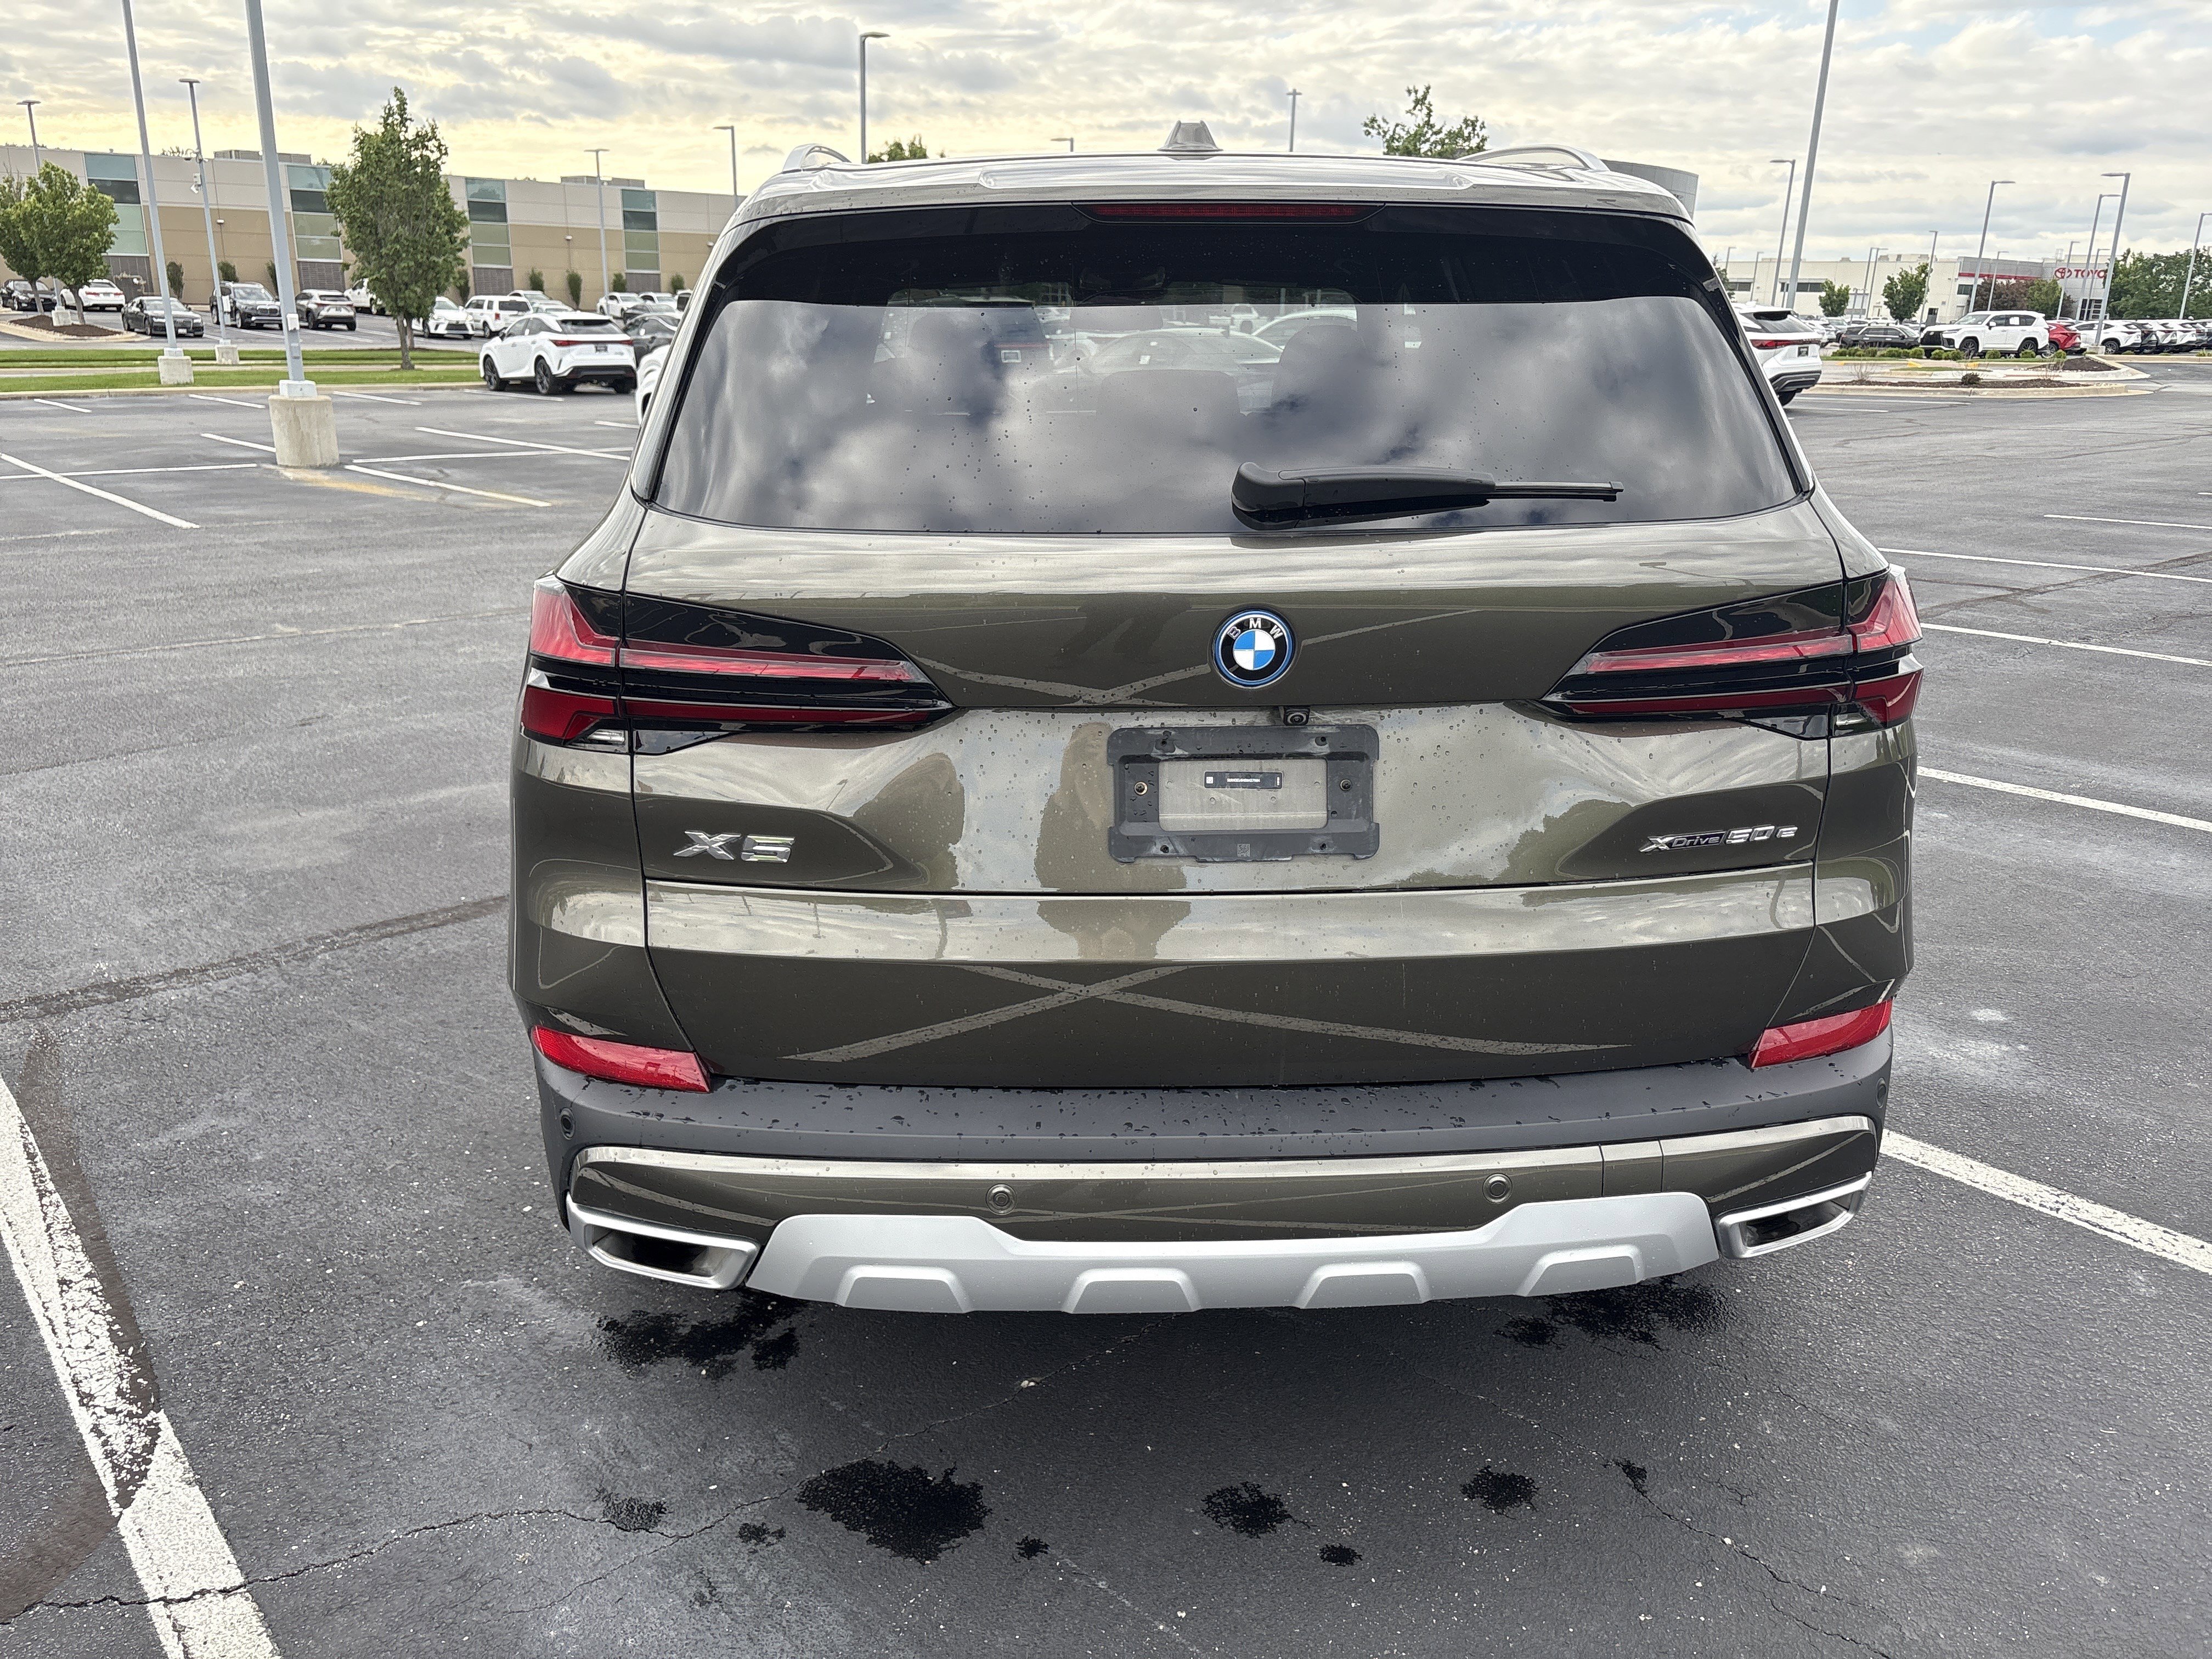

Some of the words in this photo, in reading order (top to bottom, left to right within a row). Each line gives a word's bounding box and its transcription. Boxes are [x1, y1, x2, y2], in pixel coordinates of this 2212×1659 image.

[2074, 269, 2108, 279] TOYO
[1227, 618, 1284, 640] BMW
[673, 830, 795, 863] X5
